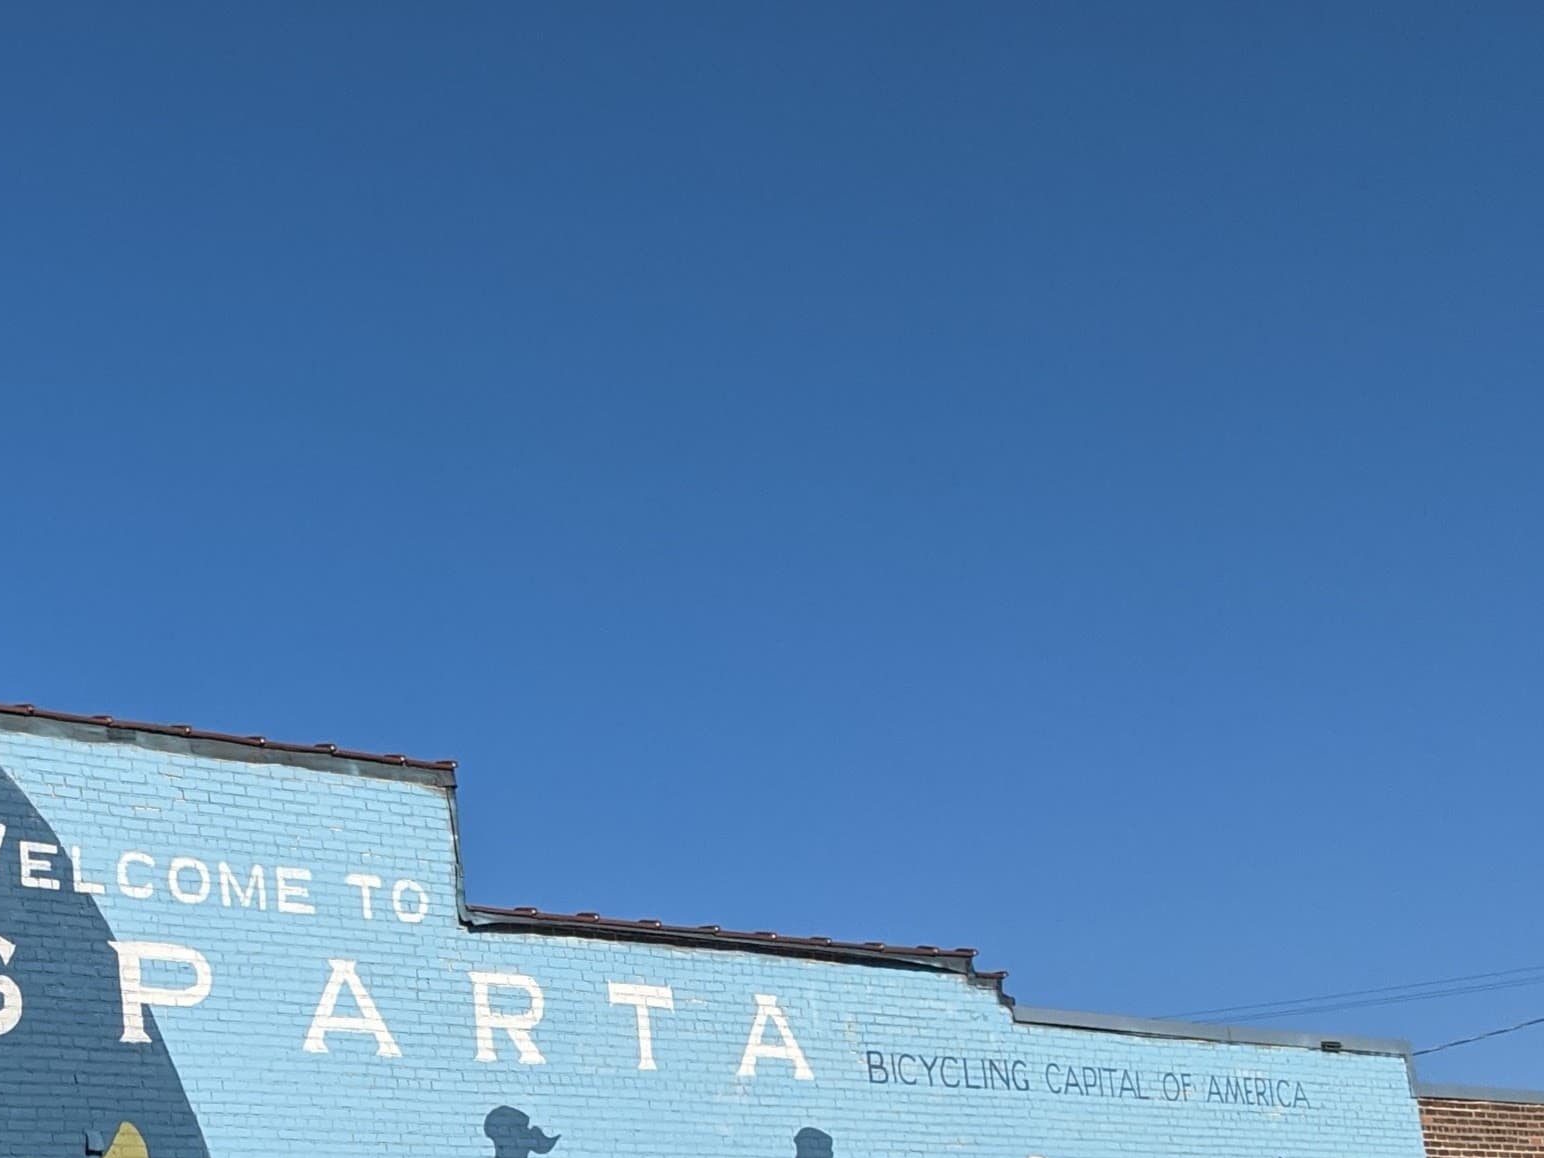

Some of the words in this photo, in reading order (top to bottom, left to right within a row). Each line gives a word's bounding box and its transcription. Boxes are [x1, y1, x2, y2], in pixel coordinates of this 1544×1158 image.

[345, 873, 431, 923] TO
[866, 1050, 1029, 1092] BICYCLING
[1045, 1063, 1151, 1100] CAPITAL
[1162, 1072, 1191, 1102] OF
[1207, 1075, 1311, 1109] AMERICA
